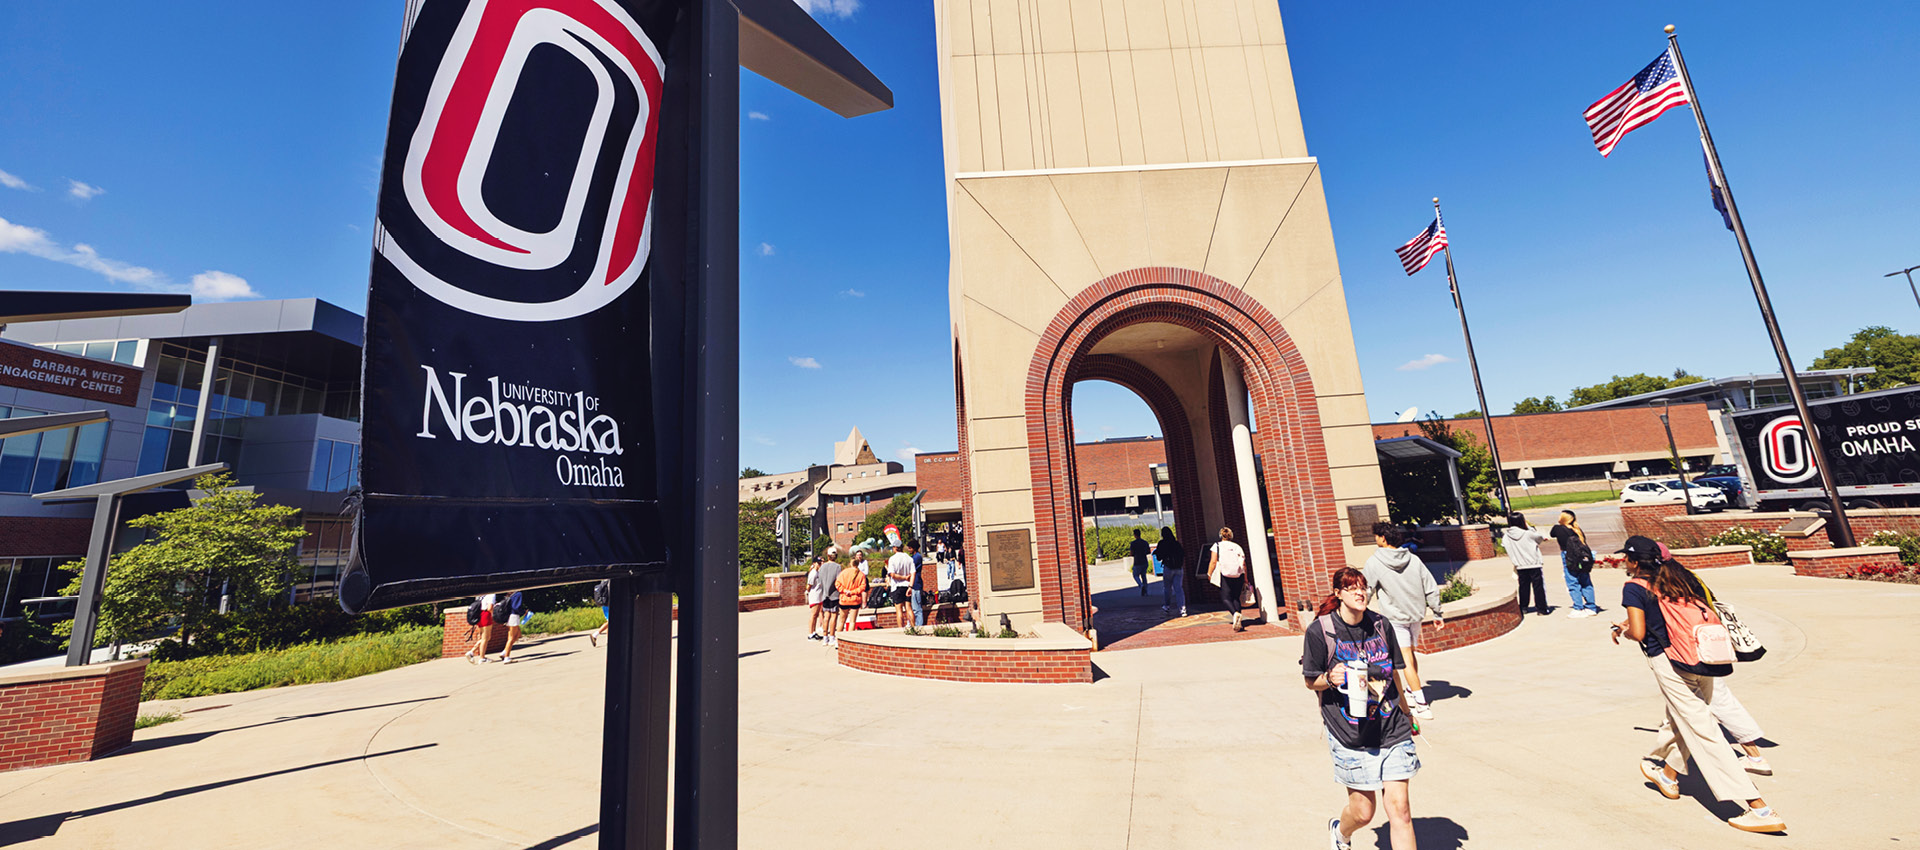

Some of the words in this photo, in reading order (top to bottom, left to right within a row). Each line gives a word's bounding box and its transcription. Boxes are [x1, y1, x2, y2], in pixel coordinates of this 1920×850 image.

[32, 358, 87, 377] BARBARA
[92, 370, 125, 384] WEITZ
[80, 380, 122, 395] CENTER
[502, 382, 572, 407] UNIVERSITY
[585, 396, 600, 411] OF
[416, 364, 624, 455] Nebraska
[1846, 421, 1902, 437] PROUD
[1841, 435, 1916, 457] OMAHA
[556, 454, 625, 488] Omaha
